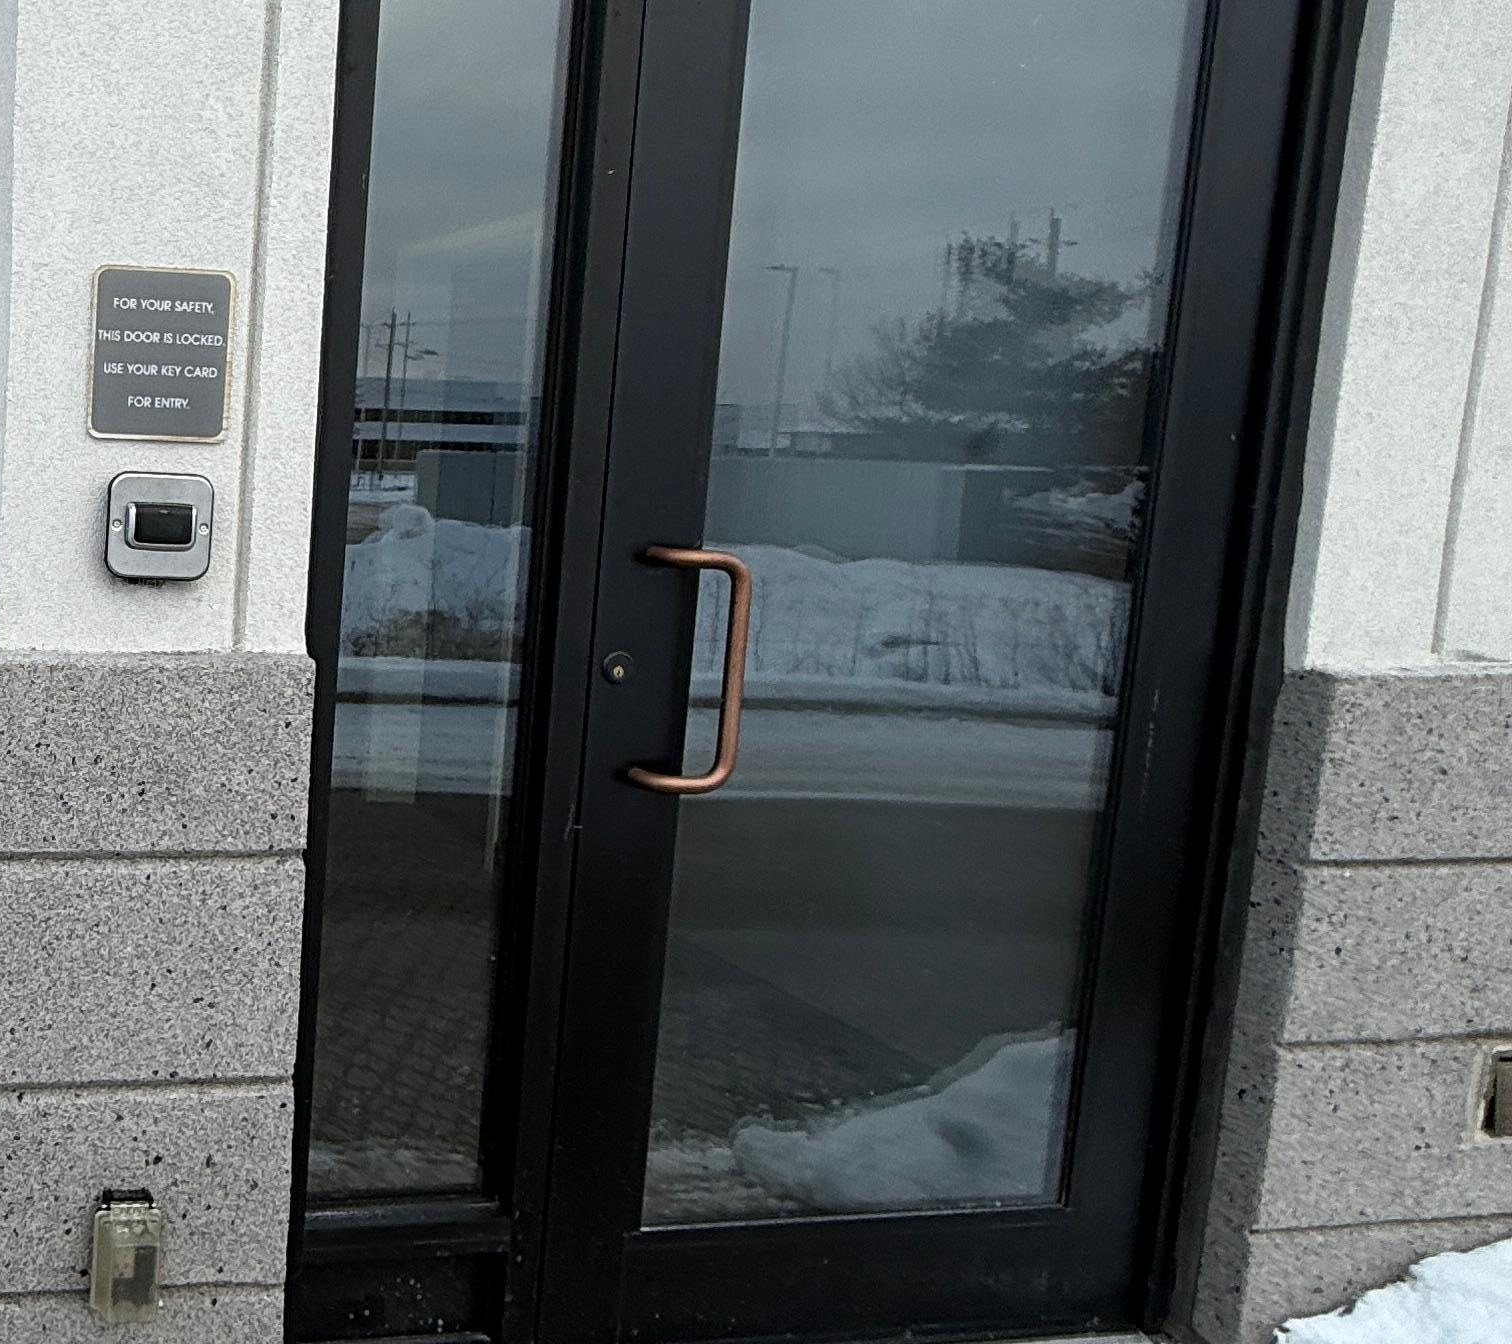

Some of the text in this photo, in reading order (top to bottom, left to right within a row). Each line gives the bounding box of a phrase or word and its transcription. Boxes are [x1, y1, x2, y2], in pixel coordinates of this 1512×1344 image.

[113, 297, 137, 310] FOR
[140, 299, 172, 311] YOUR
[98, 329, 225, 347] THIS DOOR IS LOCKED.
[103, 362, 218, 378] USE YOUR KEY CARD
[127, 395, 152, 408] FOR
